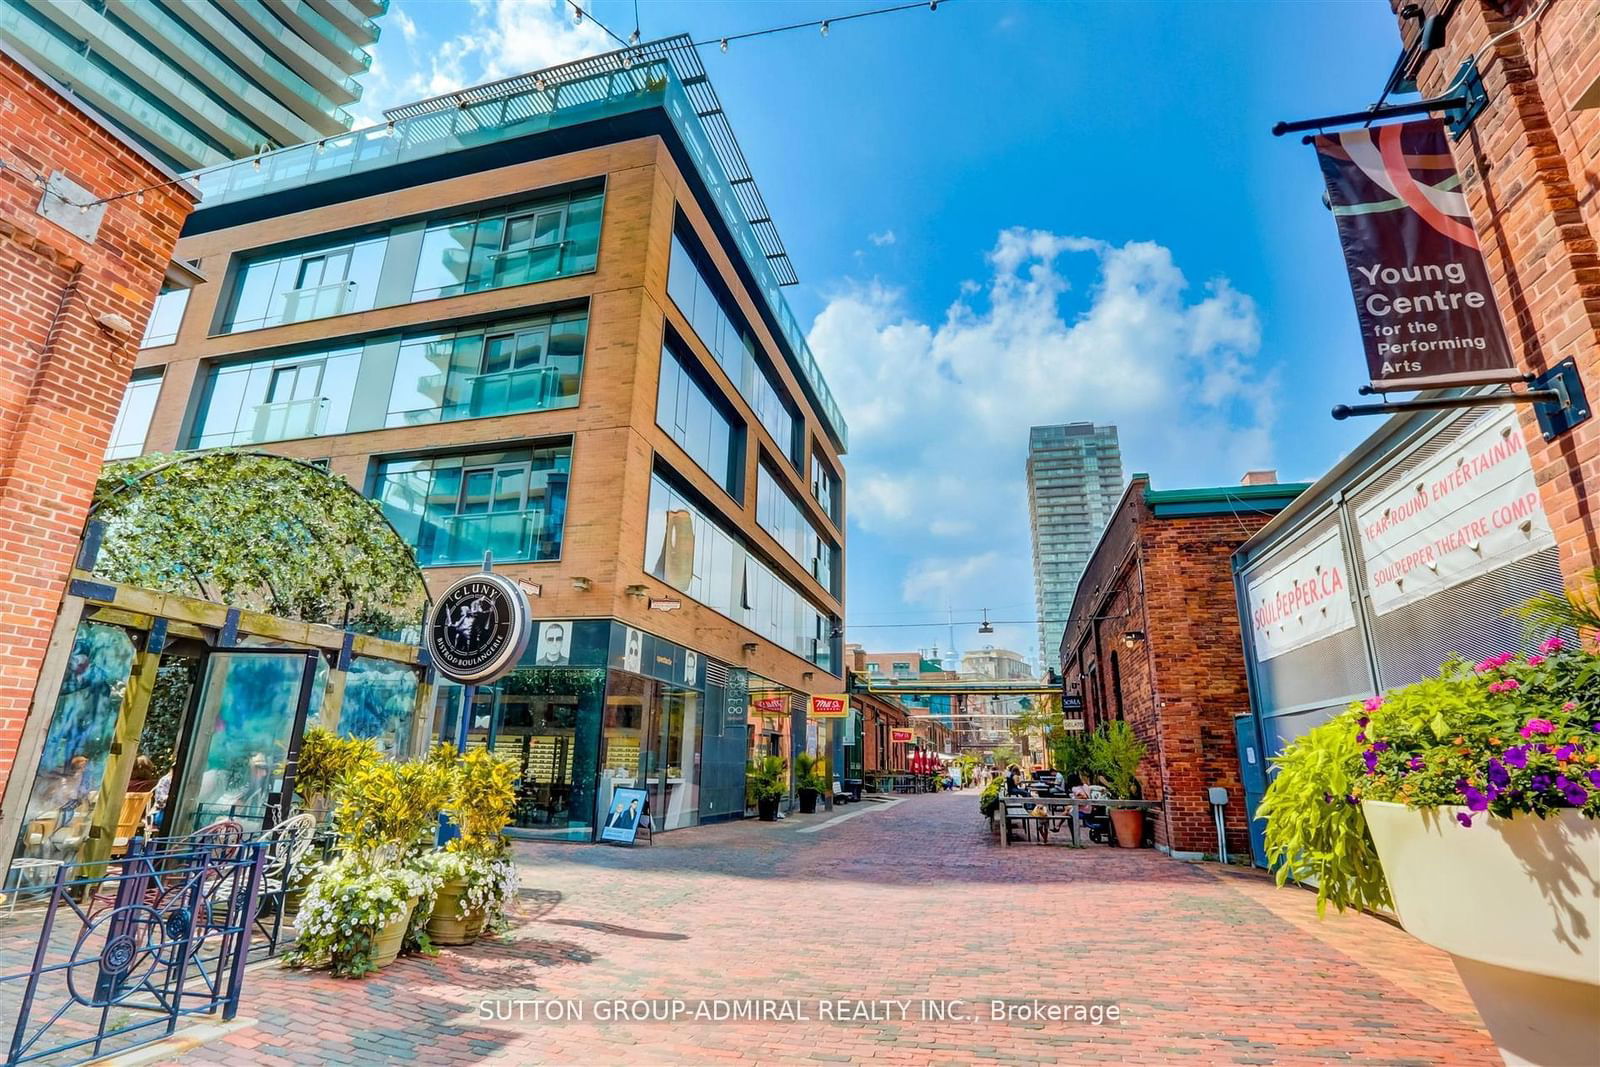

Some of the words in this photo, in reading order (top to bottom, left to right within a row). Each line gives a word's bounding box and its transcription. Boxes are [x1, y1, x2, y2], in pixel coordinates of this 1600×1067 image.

[1357, 262, 1466, 285] Young
[1366, 290, 1485, 316] Centre
[1374, 324, 1401, 336] for
[1407, 321, 1438, 333] the
[1377, 336, 1487, 355] Performing
[1381, 360, 1422, 374] Arts
[1365, 491, 1429, 543] YEAR-ROUND
[1431, 432, 1523, 501] ENTERTAINM
[1373, 545, 1433, 587] SOULPEPPER
[1436, 517, 1490, 556] THEATRE
[1491, 492, 1542, 529] COMP
[454, 583, 498, 601] CLUNY
[1254, 567, 1343, 631] SOULPEPPER.CA
